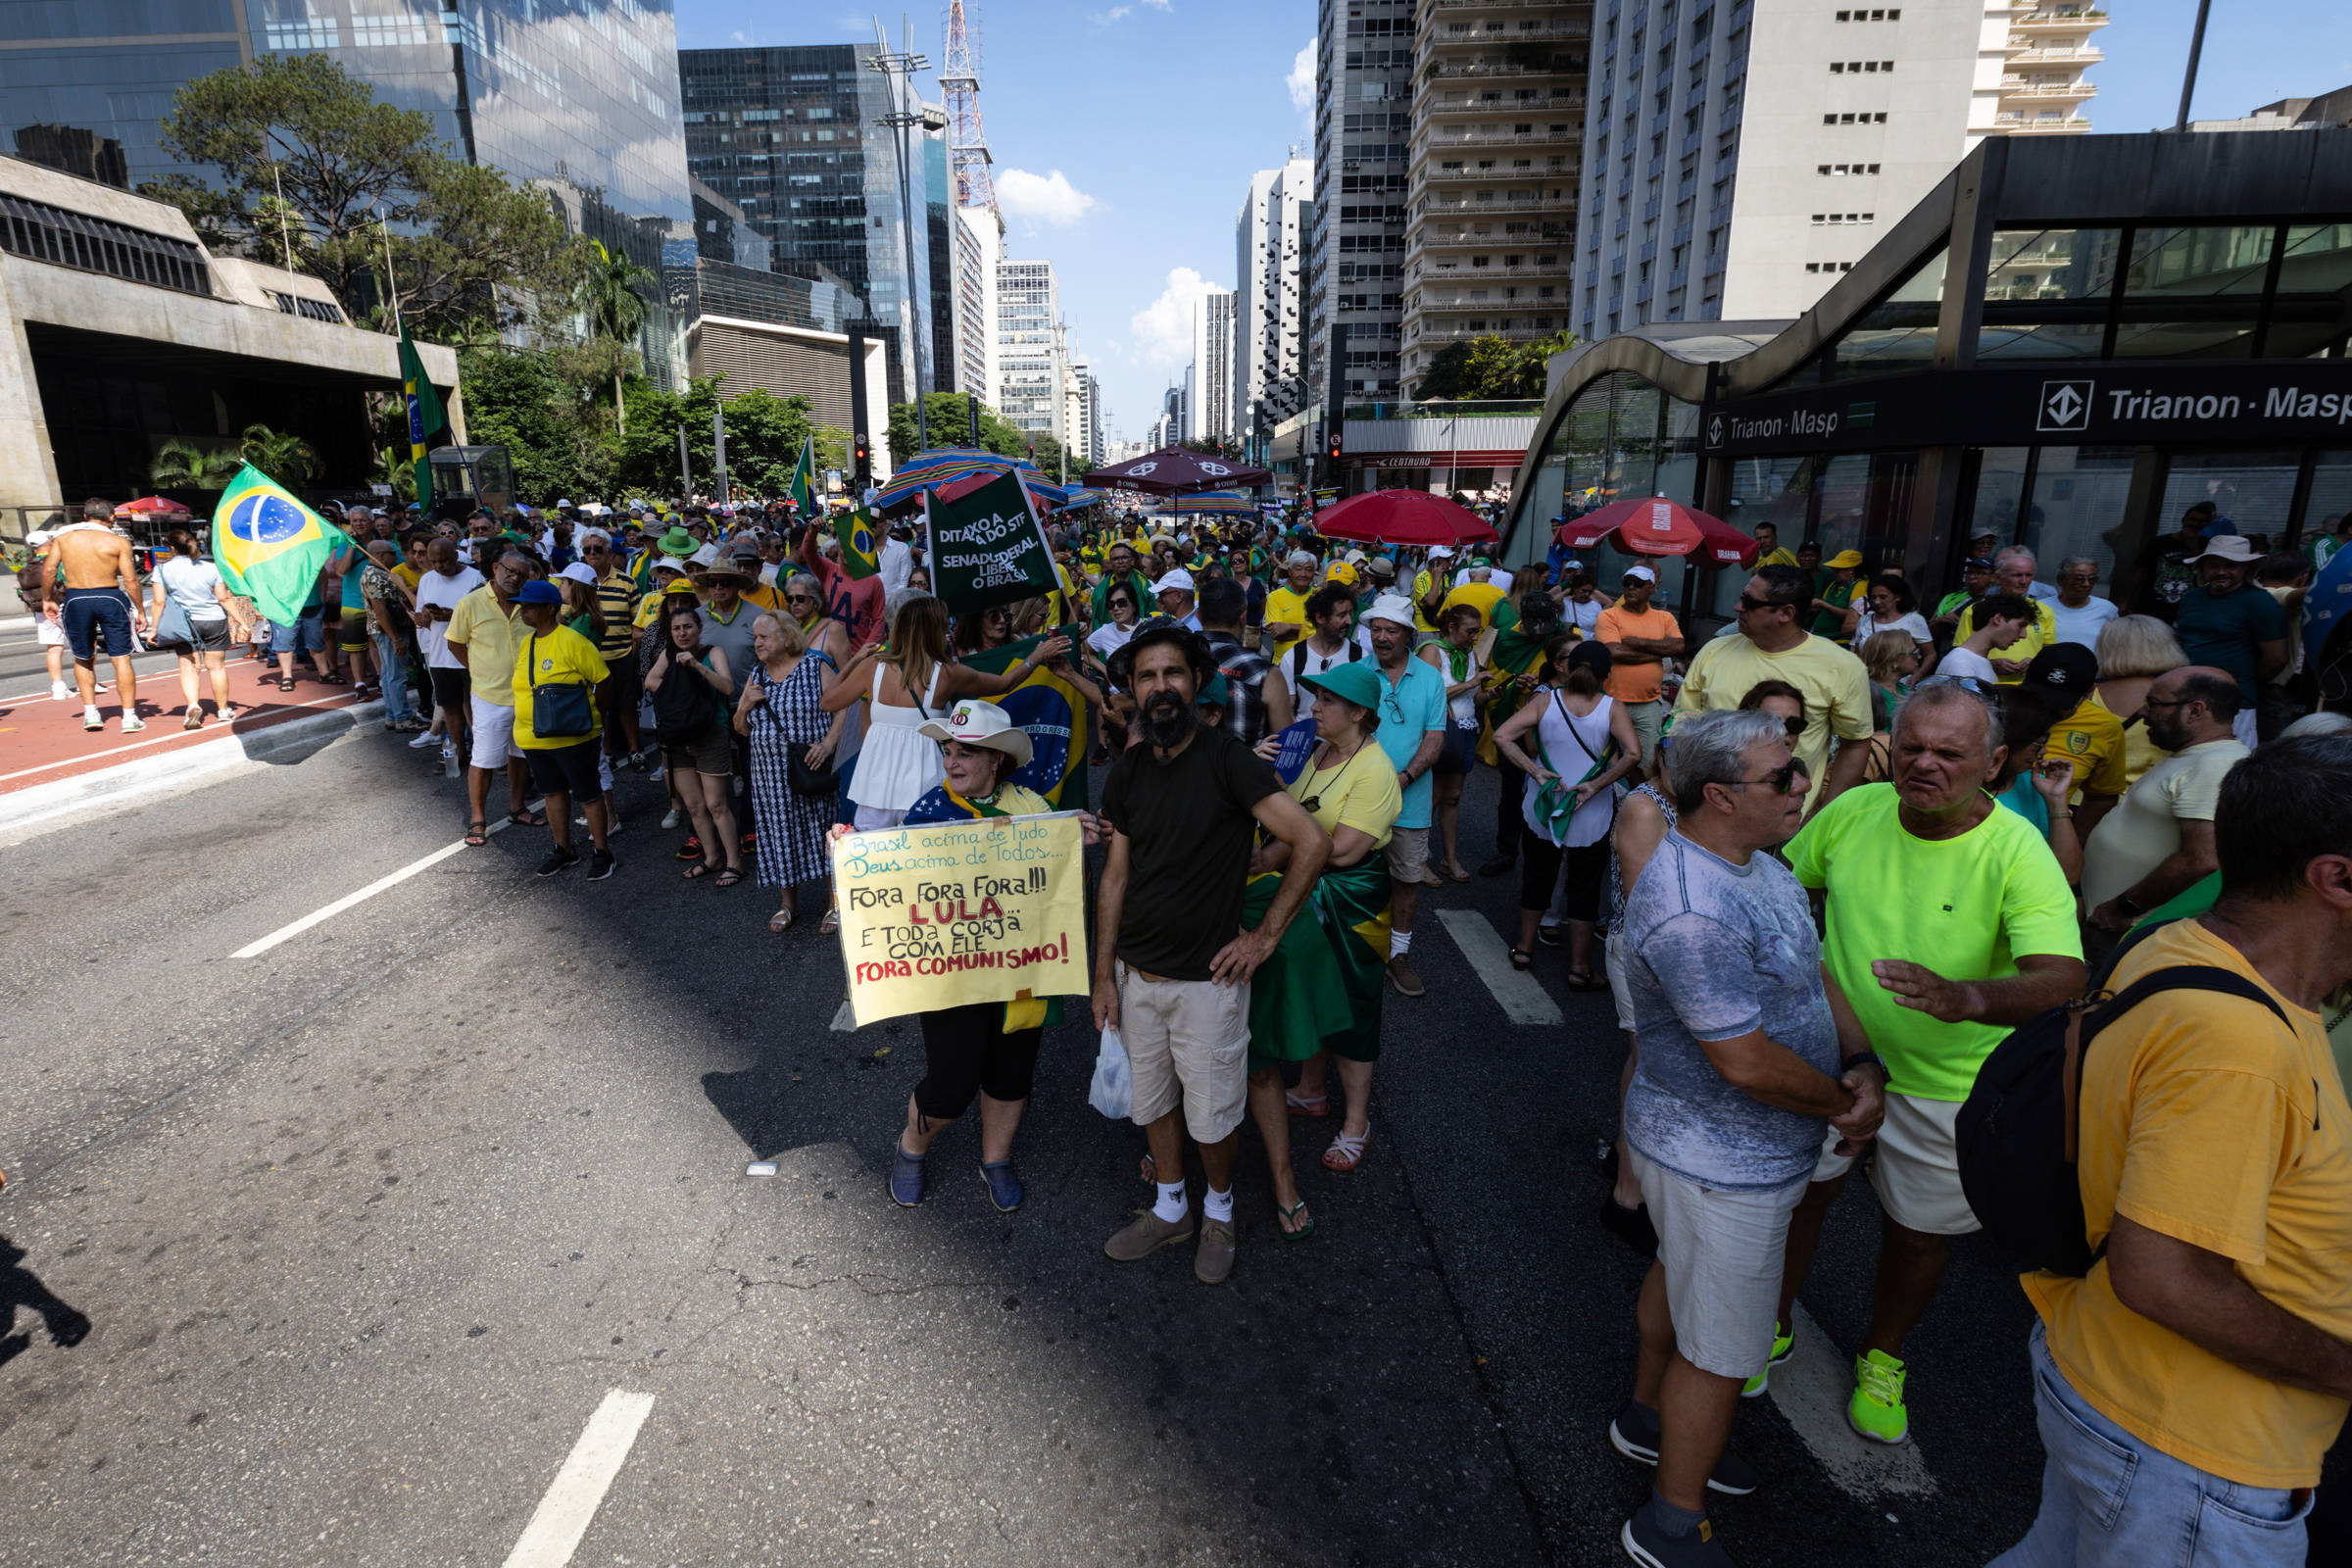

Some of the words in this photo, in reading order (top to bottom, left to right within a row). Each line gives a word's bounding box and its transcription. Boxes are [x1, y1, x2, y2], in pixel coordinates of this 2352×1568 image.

[2108, 389, 2241, 420] Trianon
[1730, 417, 1782, 440] Trianon
[1790, 409, 1838, 438] Masp
[1389, 457, 1431, 466] CENTAURO
[1006, 511, 1026, 532] STF
[1652, 503, 1672, 531] BRAHMA
[971, 576, 985, 590] O
[849, 830, 911, 858] Brasil
[921, 832, 981, 848] acima
[986, 823, 1004, 842] de
[1004, 822, 1049, 841] Tudo
[844, 857, 904, 878] Deus
[905, 854, 960, 870] acima
[965, 846, 988, 864] de
[860, 927, 876, 948] E
[888, 941, 945, 959] COM
[952, 935, 988, 955] ELE
[915, 932, 1069, 976] COMUNISMO!
